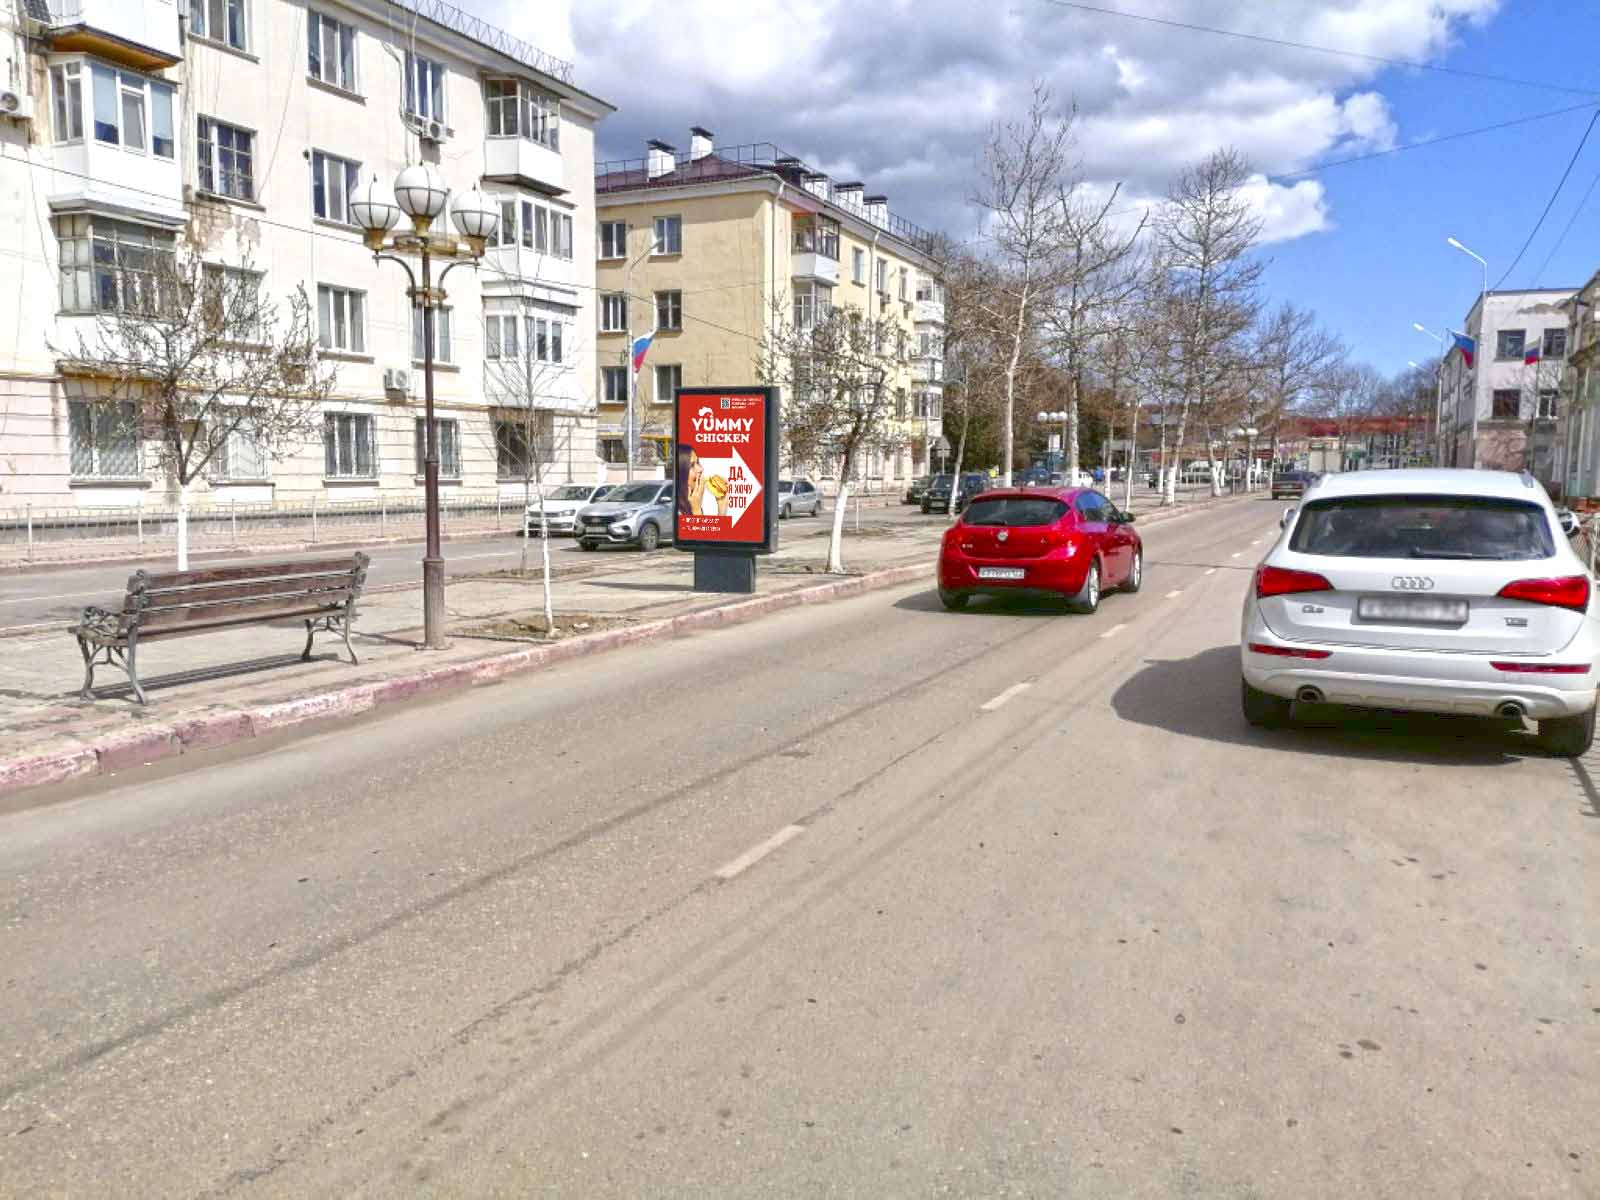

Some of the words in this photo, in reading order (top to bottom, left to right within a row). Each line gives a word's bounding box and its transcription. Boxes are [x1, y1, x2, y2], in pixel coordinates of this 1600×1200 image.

[691, 417, 754, 431] YUMMY
[695, 433, 750, 443] CHICKEN
[728, 466, 747, 482] ДА,
[728, 484, 733, 494] Я
[735, 484, 753, 494] ХОЧУ
[728, 496, 747, 508] ЭТО!
